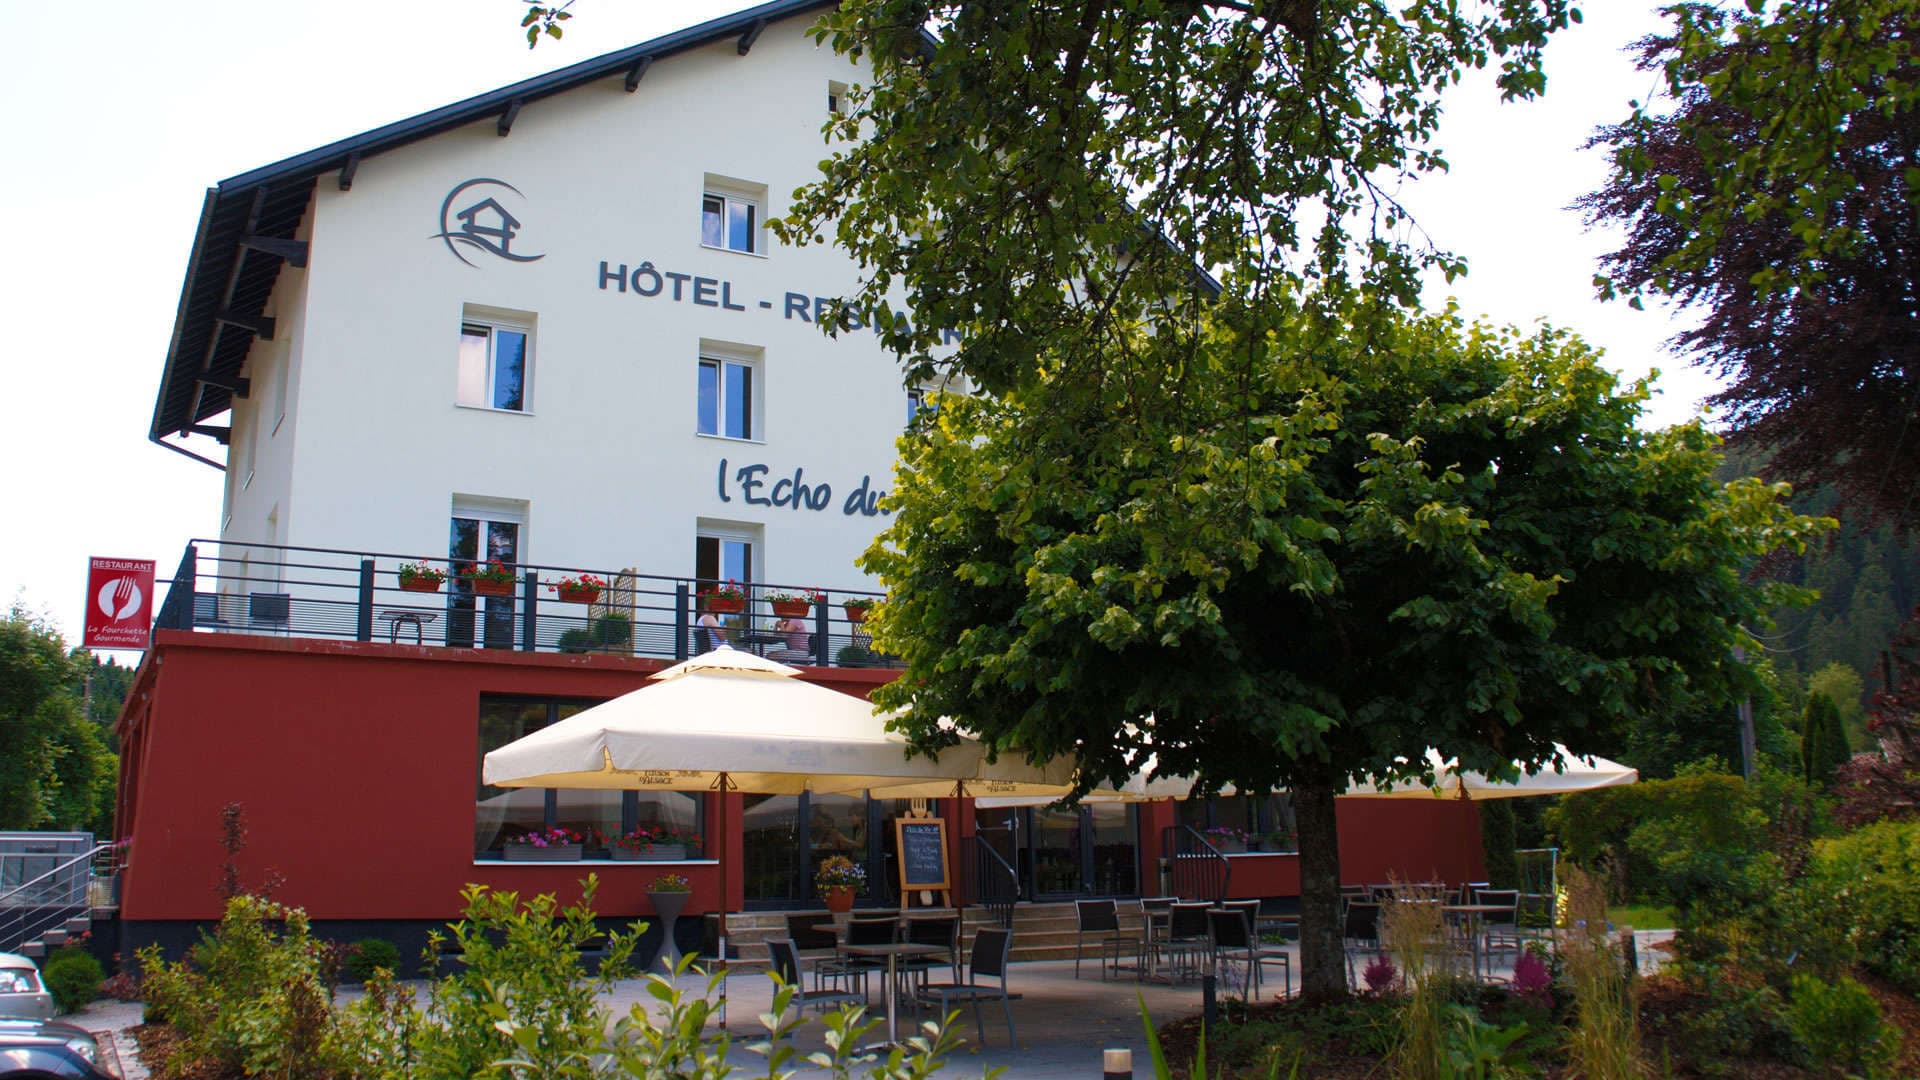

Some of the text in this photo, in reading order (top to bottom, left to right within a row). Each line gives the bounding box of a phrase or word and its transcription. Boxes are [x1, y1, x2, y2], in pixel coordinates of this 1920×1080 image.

[598, 261, 746, 311] HÔTEL
[843, 475, 891, 517] du
[92, 559, 153, 571] RESTAURANT
